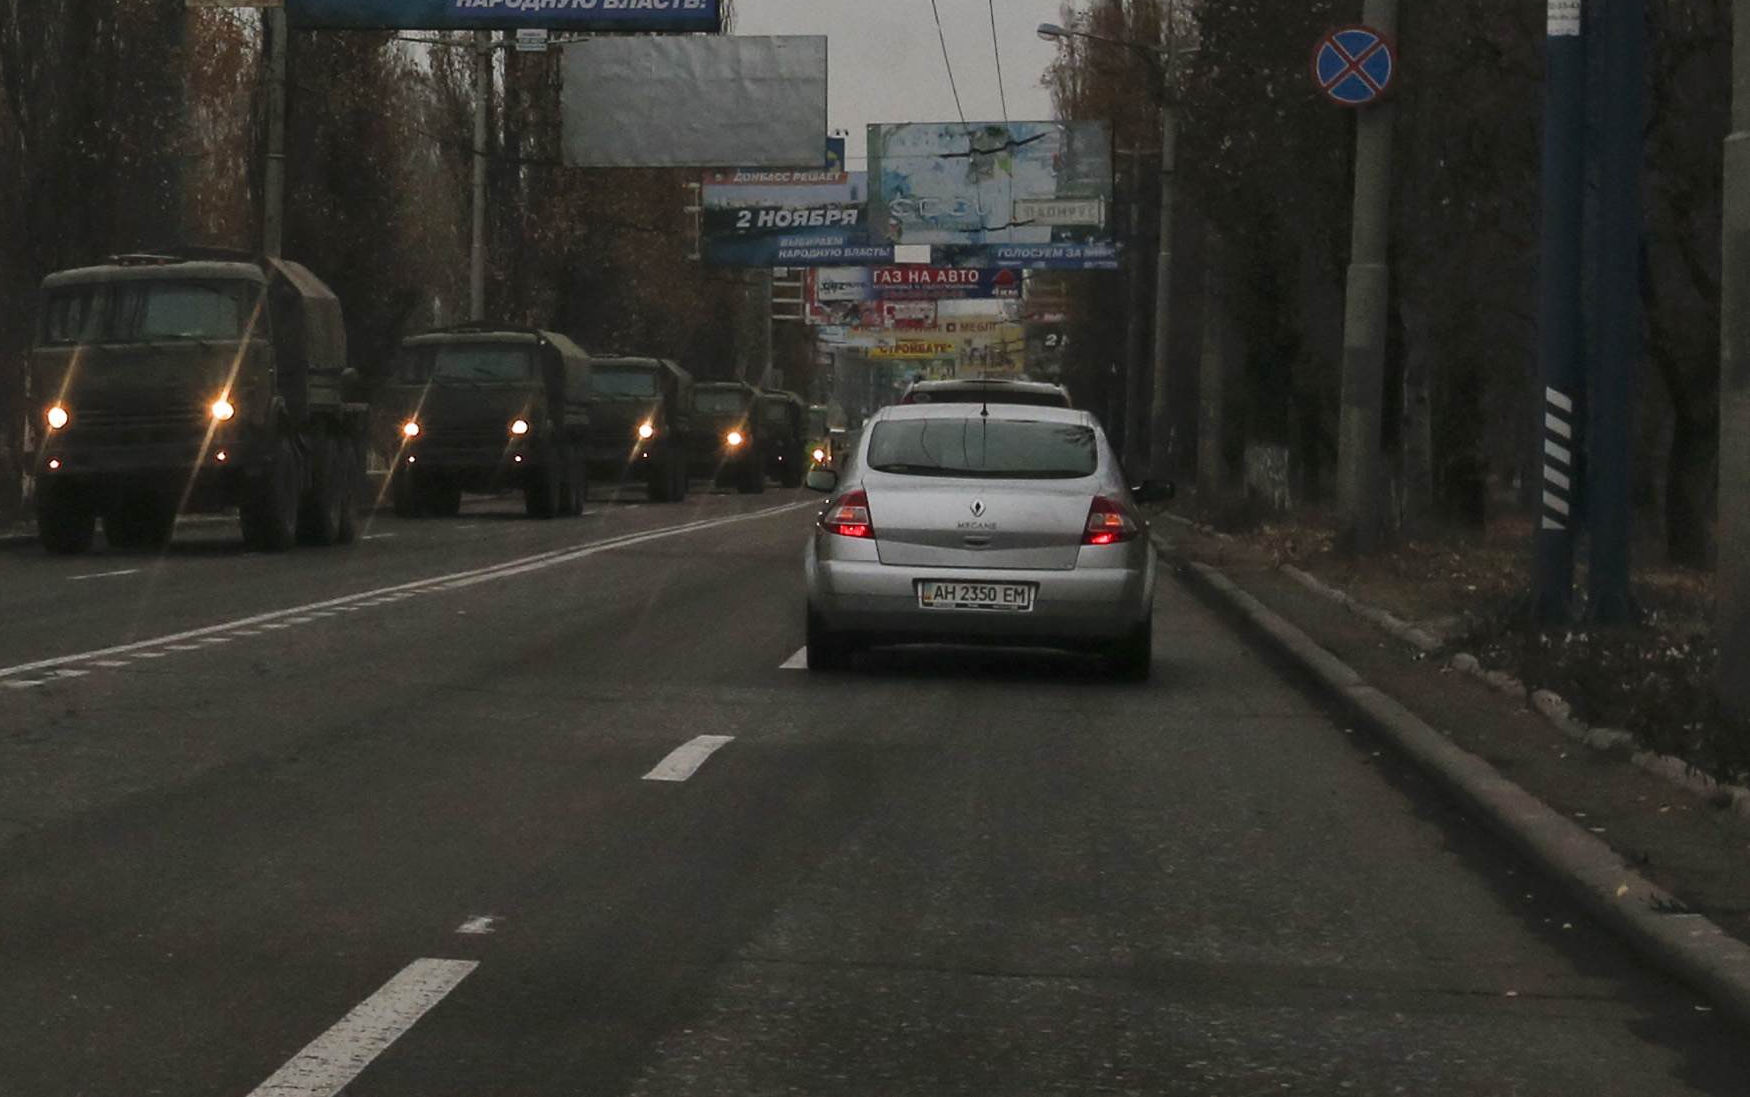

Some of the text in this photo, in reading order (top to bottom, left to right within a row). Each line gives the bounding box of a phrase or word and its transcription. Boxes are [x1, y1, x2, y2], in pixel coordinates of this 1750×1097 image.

[733, 171, 841, 183] ДОНБАСС РЕШАЕТ
[736, 209, 858, 227] 2 НОЯБРЯ
[780, 237, 843, 246] ВЫБИРАЕМ
[779, 247, 890, 259] НАРОДНУЮ ВЛАСТЬ!
[997, 247, 1063, 258] ГОЛОСУЕМ
[873, 269, 979, 283] ГАЗ НА АВТО
[934, 585, 1026, 603] AH 2350 EM
